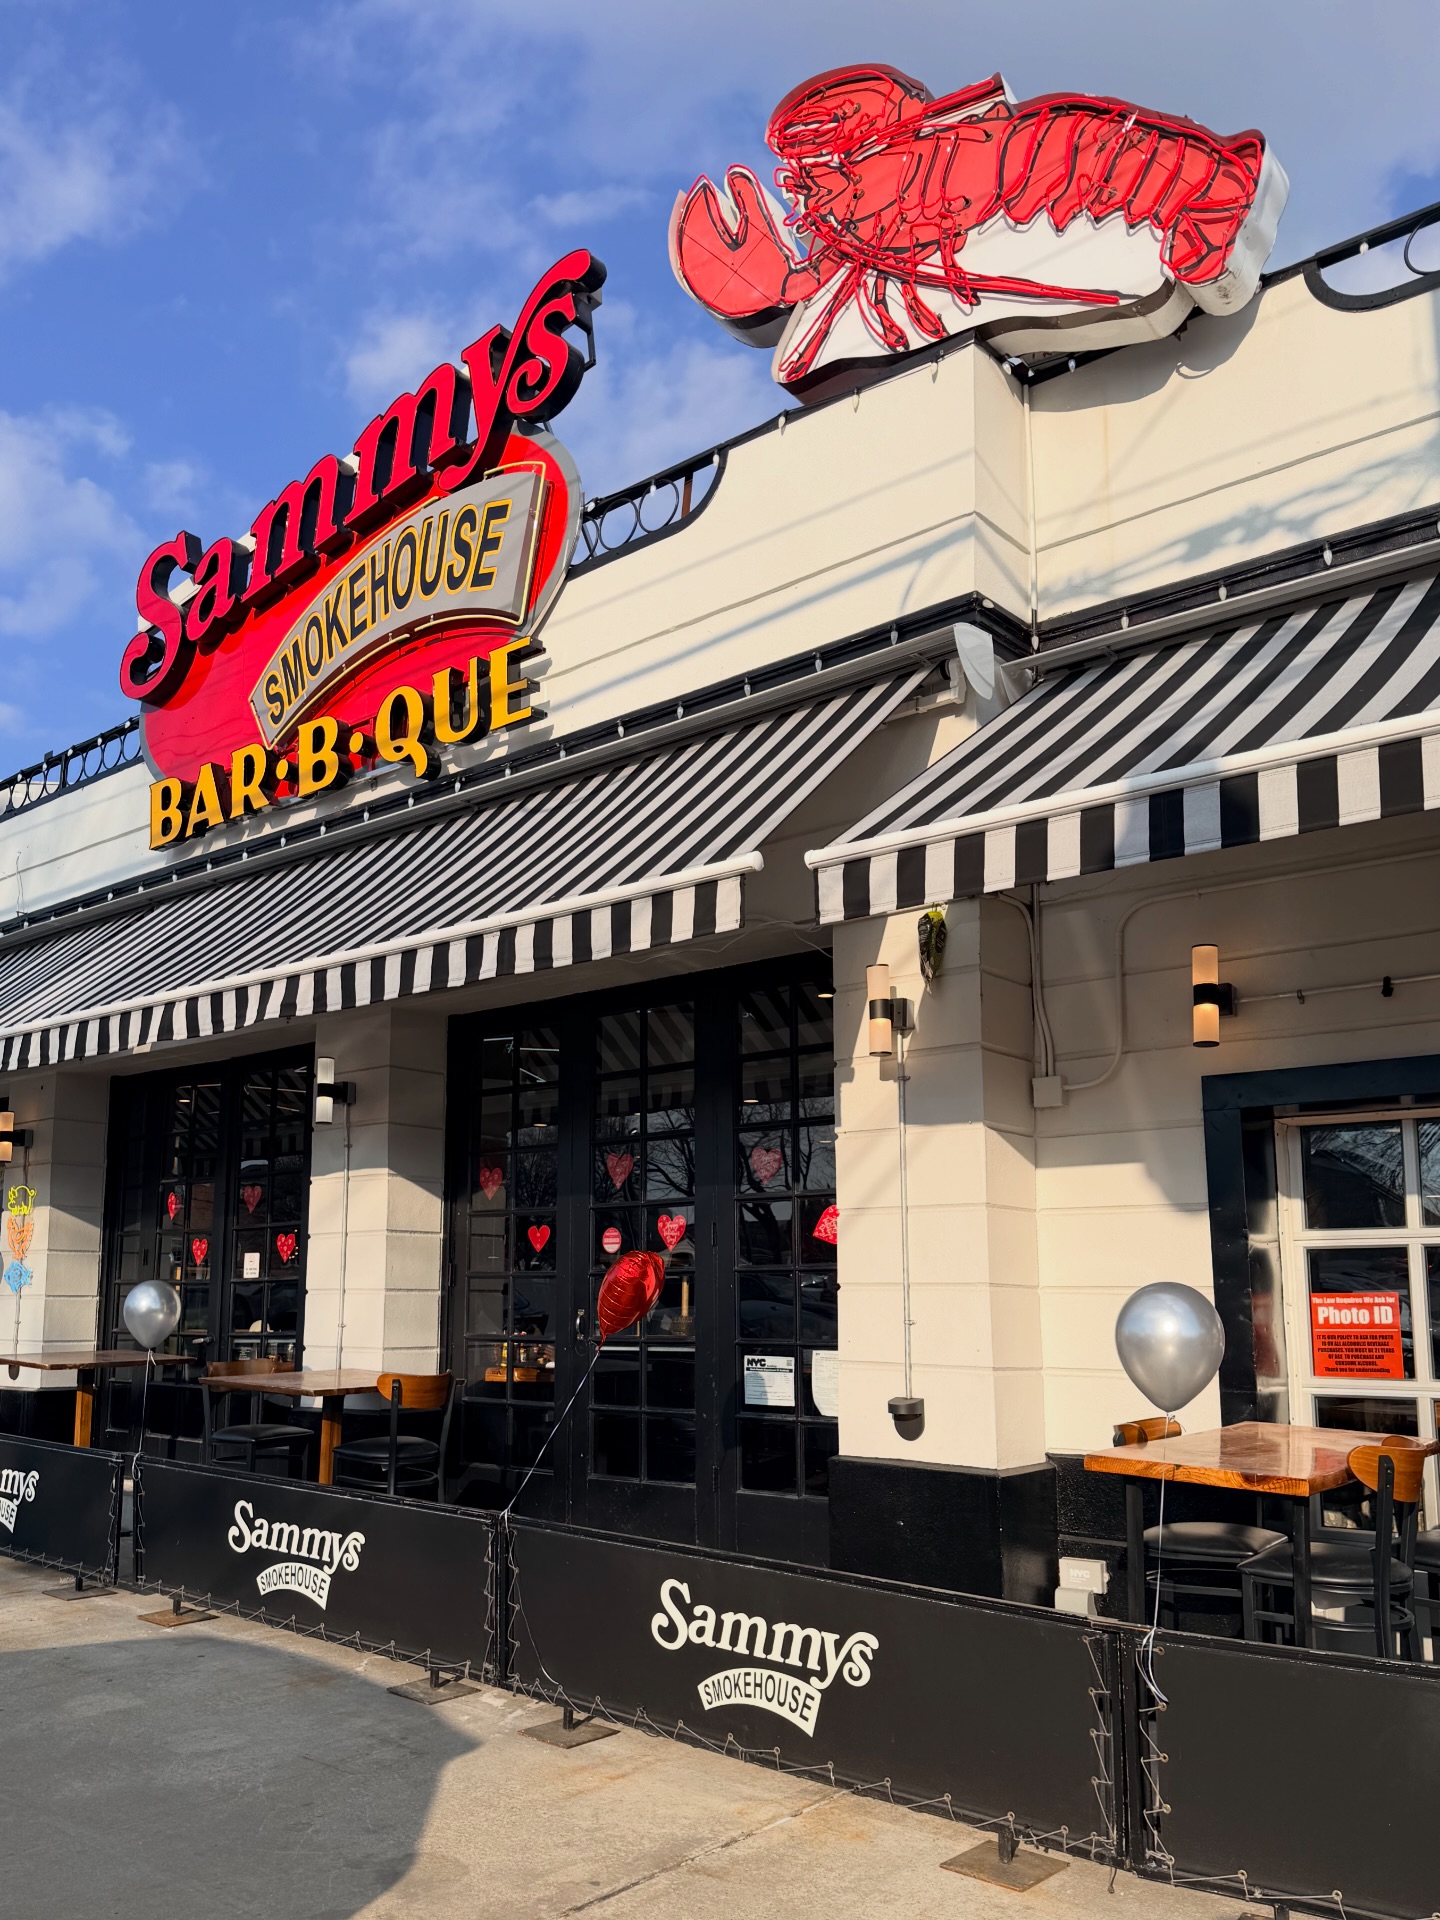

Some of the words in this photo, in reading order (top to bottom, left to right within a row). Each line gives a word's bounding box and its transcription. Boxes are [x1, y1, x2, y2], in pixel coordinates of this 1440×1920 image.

[119, 248, 600, 701] Sammys
[262, 498, 512, 729] SMOKEHOUSE
[1317, 1306, 1370, 1324] Photo
[1373, 1306, 1393, 1324] ID
[1336, 1296, 1362, 1304] Requires
[746, 1358, 766, 1367] NYC
[228, 1500, 366, 1574] Sammys
[260, 1565, 327, 1600] SMOKEHOUSE
[651, 1578, 880, 1690] Sammys
[704, 1672, 815, 1722] SMOKEHOUSE
